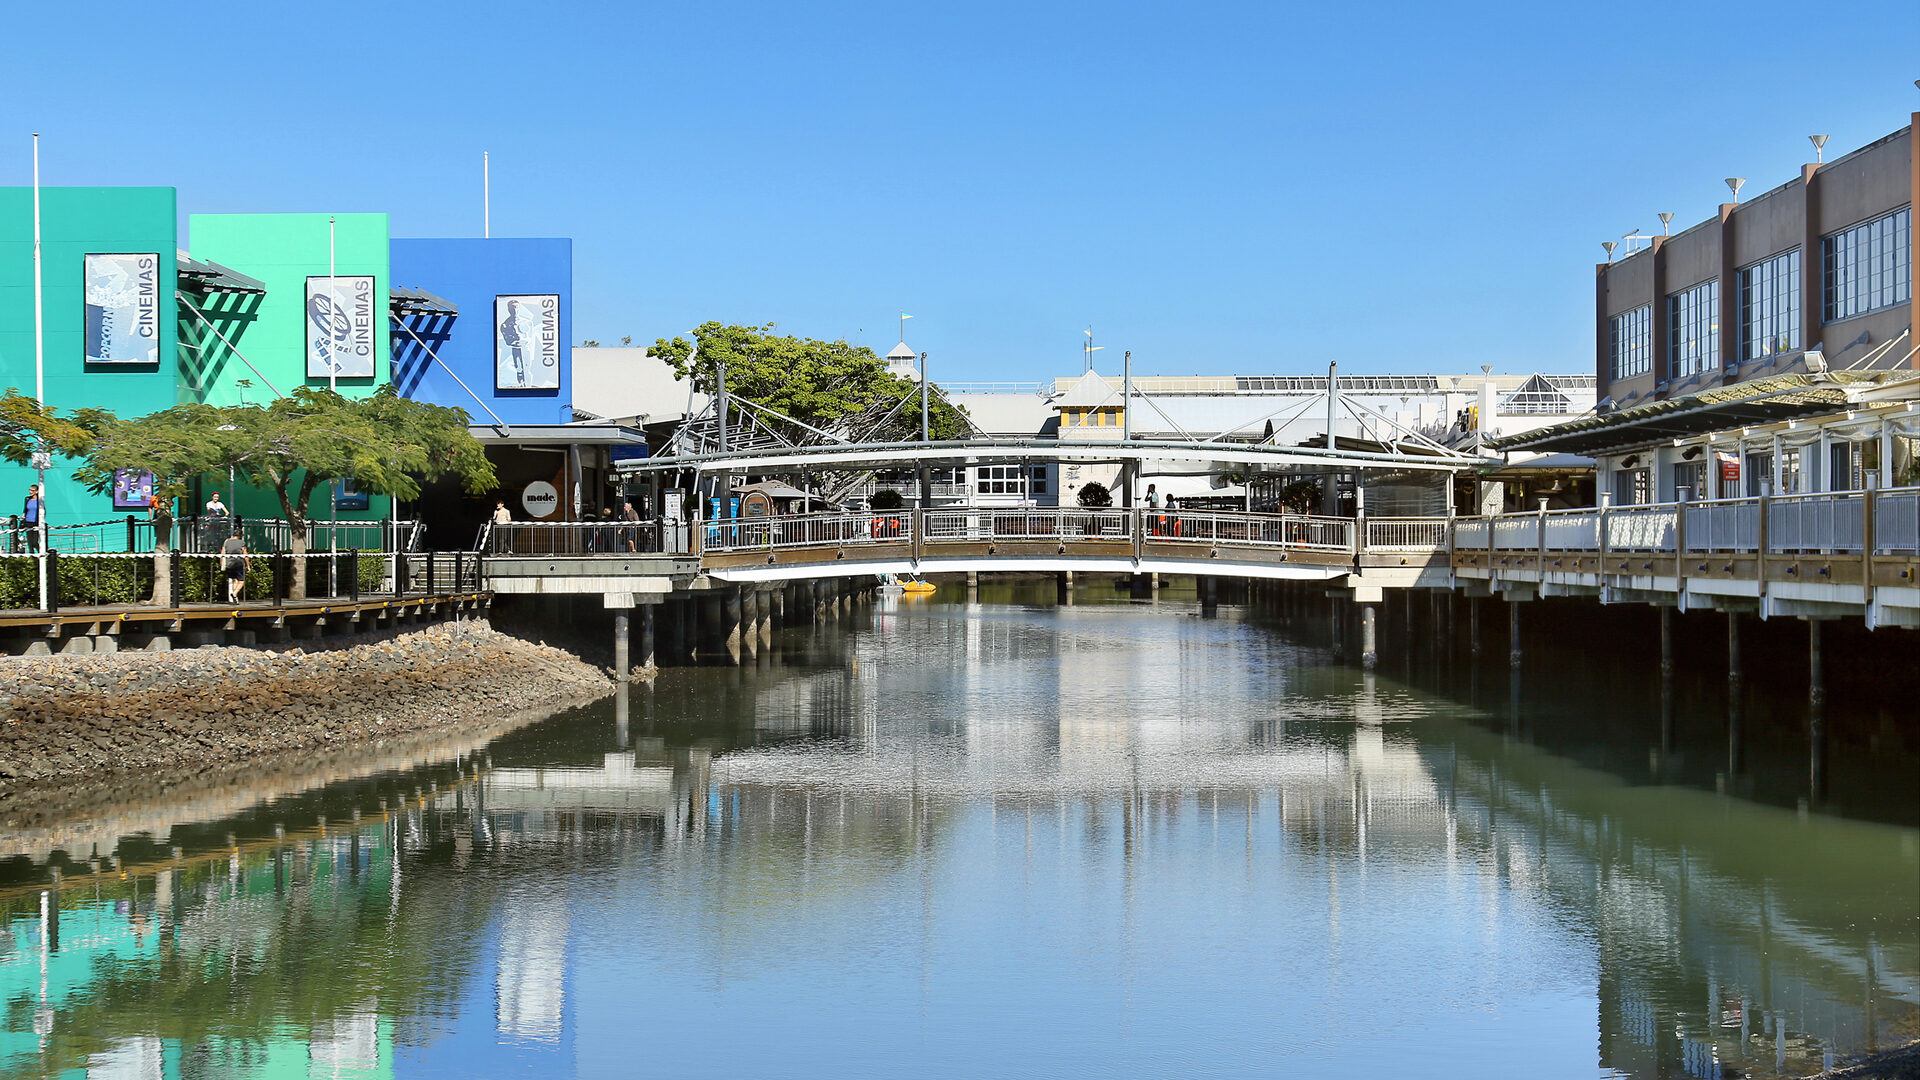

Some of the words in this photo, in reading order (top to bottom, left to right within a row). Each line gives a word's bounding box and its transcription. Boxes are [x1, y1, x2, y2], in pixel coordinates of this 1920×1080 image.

[100, 305, 114, 359] POPCORN
[139, 258, 153, 338] CINEMAS
[355, 280, 369, 356] CINEMAS
[542, 298, 555, 367] CINEMAS
